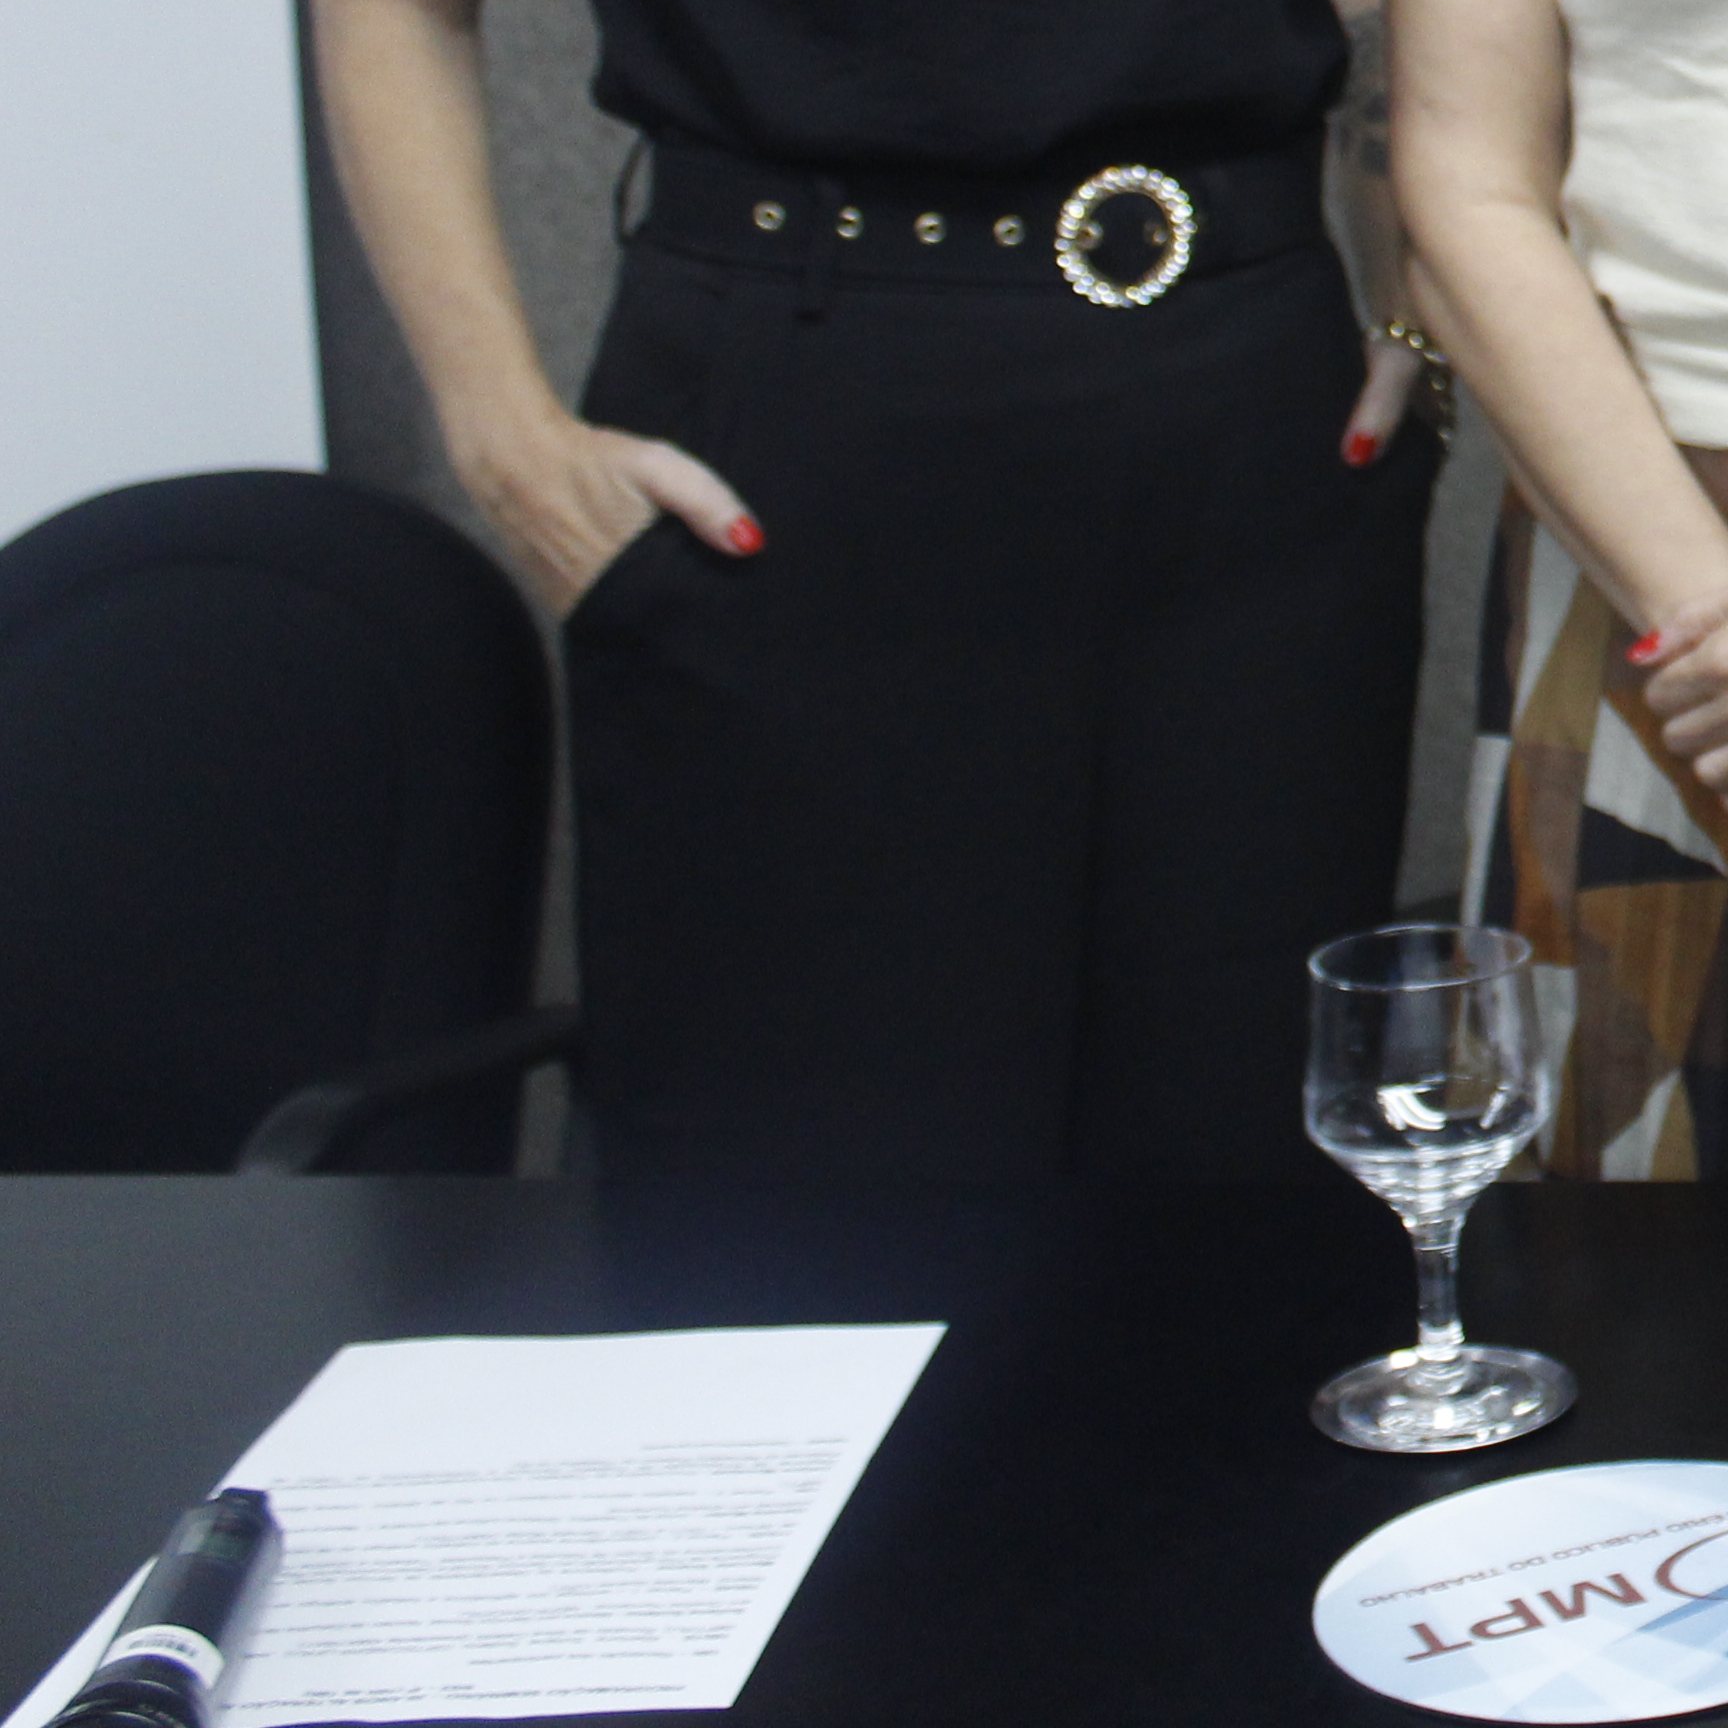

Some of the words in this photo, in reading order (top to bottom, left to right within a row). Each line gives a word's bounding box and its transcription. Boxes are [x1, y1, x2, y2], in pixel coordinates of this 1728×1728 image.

[1551, 1528, 1661, 1560] PÚBLICO
[1508, 1555, 1547, 1572] DO
[1359, 1567, 1504, 1607] TRABALHO
[1405, 1572, 1649, 1662] MPT
